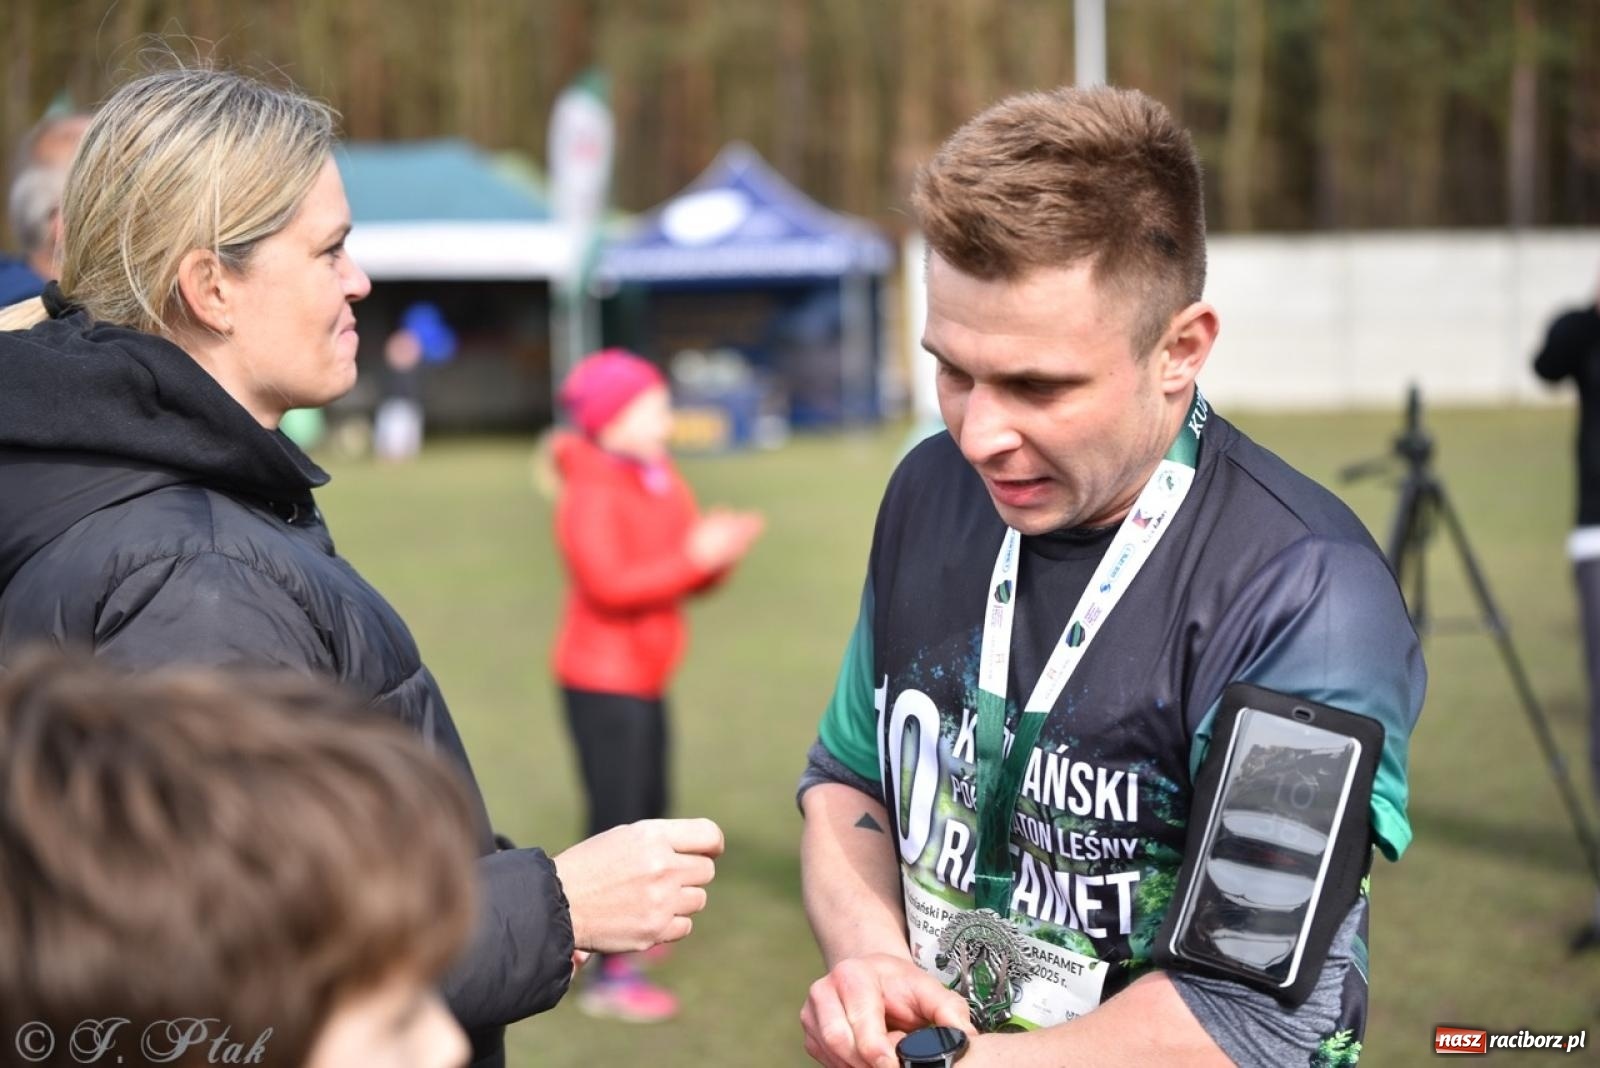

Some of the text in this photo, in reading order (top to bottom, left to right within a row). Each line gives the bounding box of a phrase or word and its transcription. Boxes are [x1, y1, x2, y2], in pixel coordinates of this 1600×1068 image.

[951, 708, 1139, 823] KAŃSKI
[1056, 829, 1139, 861] LEŚNY
[935, 818, 1141, 939] RAAMET
[1031, 946, 1085, 977] RAFAMET
[1032, 964, 1060, 984] 2025
